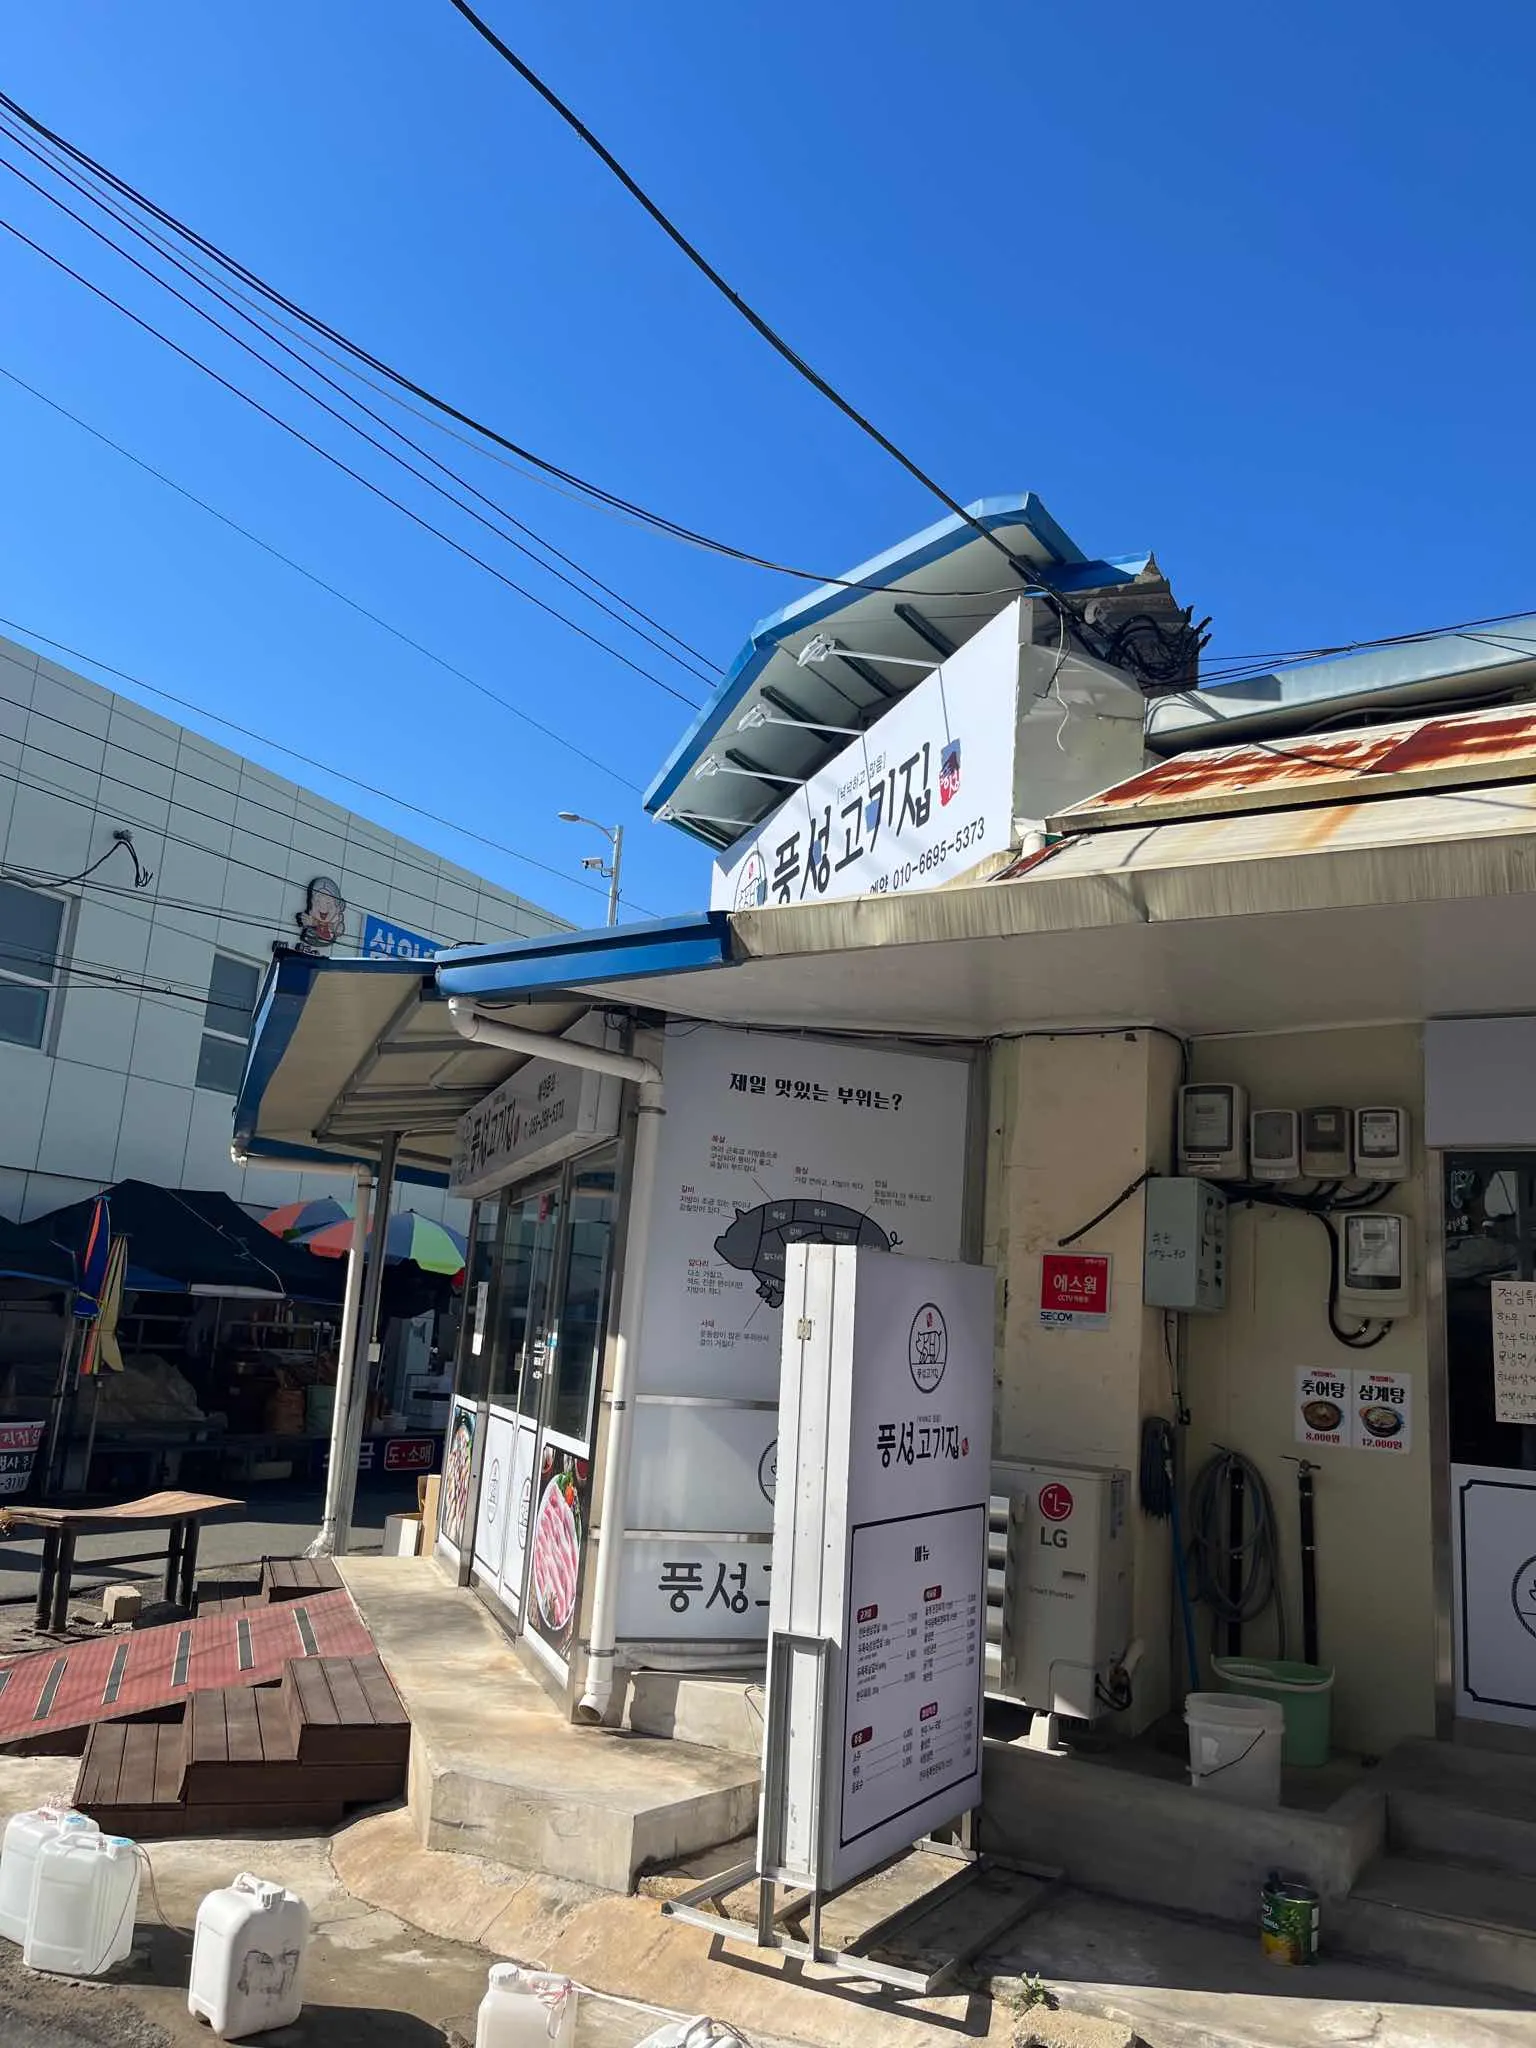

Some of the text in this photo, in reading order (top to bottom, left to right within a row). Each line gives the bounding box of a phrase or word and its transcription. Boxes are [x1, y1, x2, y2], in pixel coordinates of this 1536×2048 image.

[771, 742, 931, 905] 풍성고기집
[892, 815, 986, 890] 010-6695-5373
[729, 1071, 903, 1112] 제일 맛있는 부위는?
[1053, 1273, 1097, 1295] 에스원
[1301, 1380, 1345, 1399] 추어탕
[1358, 1384, 1405, 1404] 삼계탕
[876, 1421, 961, 1468] 풍성고기집
[1040, 1526, 1068, 1549] LG
[914, 1544, 930, 1563] 메뉴
